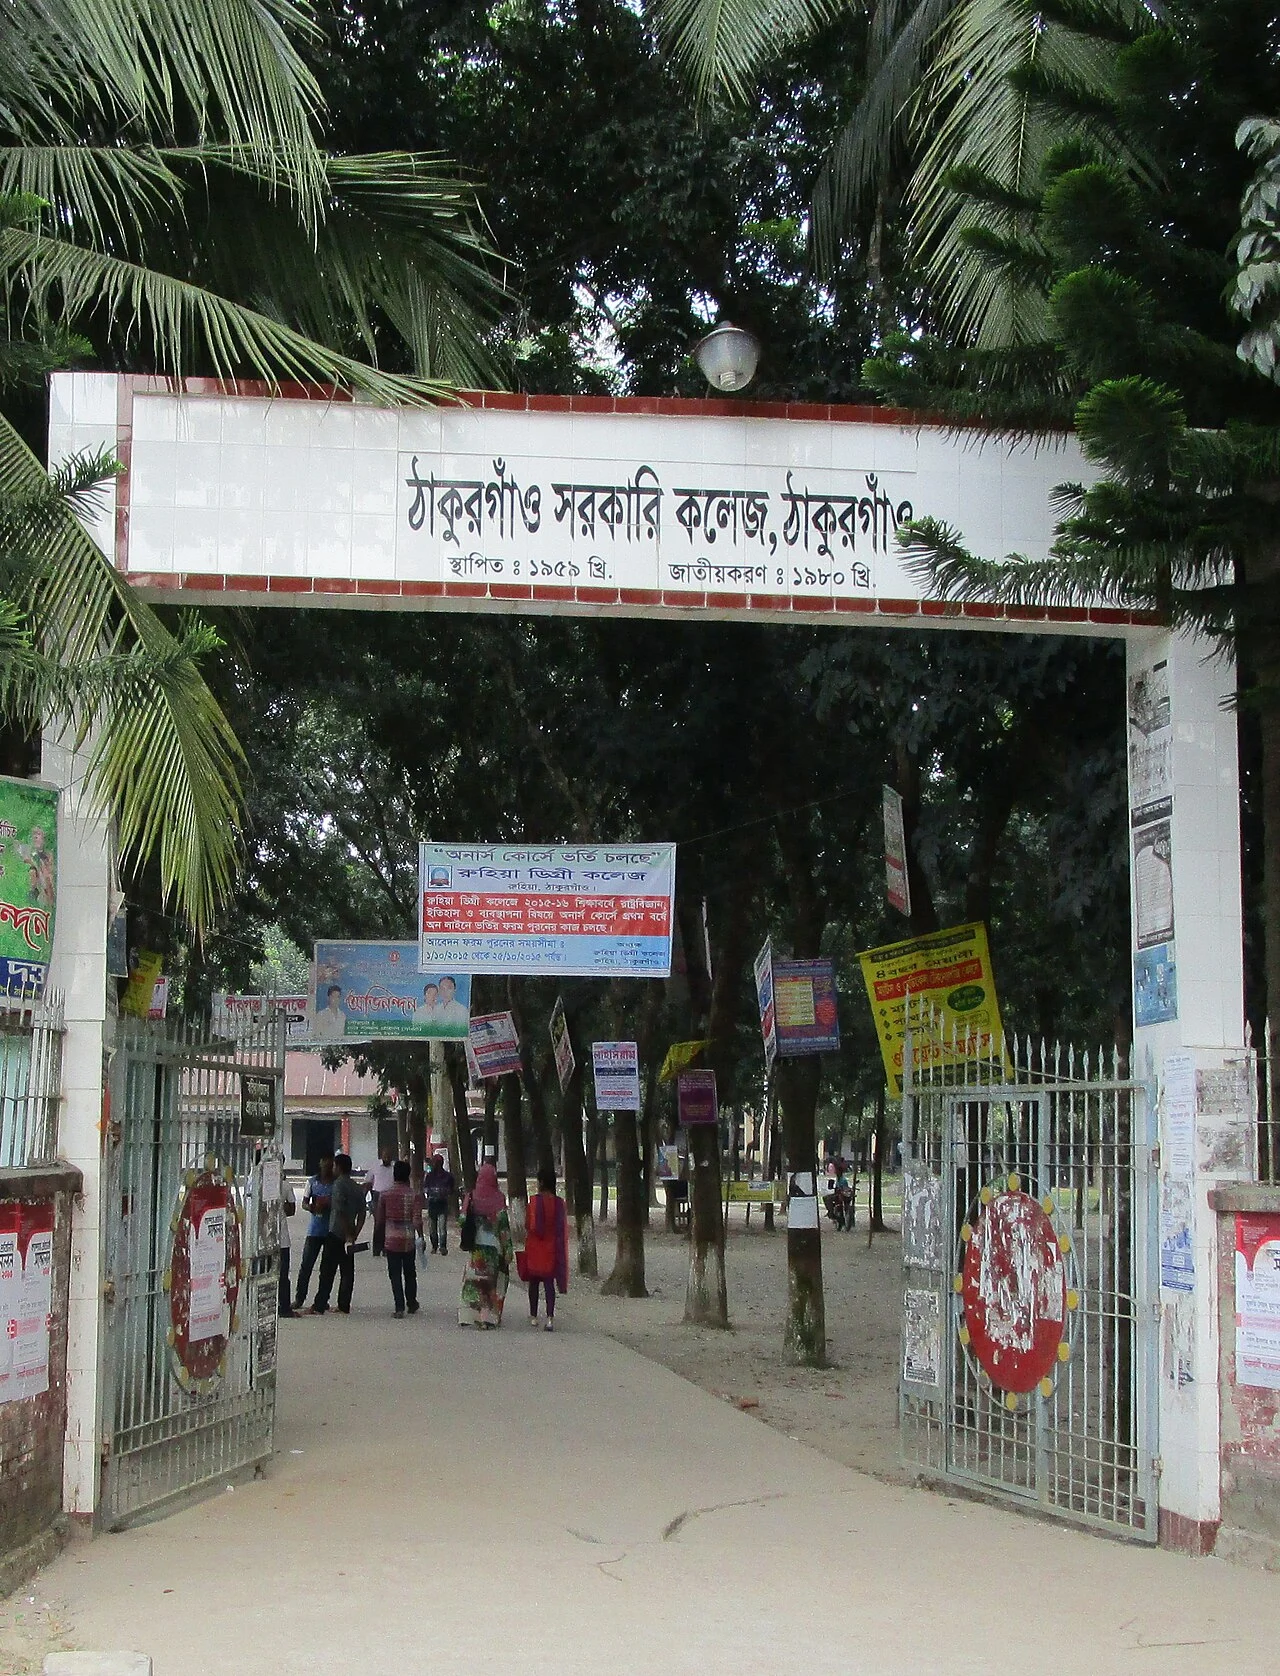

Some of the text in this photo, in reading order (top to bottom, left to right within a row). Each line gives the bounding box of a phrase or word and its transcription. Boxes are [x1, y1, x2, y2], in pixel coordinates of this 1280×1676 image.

[405, 455, 542, 548] ঠাকুরগাঁও
[550, 464, 665, 544] সরকারি
[447, 551, 504, 577] স্থাপিত
[529, 559, 581, 577] ১৯৫৯
[667, 557, 768, 585] জাতীয়করণ
[793, 566, 845, 586] ১৯৮০
[502, 849, 556, 862] কোর্সে
[561, 848, 598, 863] ভর্তি
[581, 870, 648, 882] কলেজ
